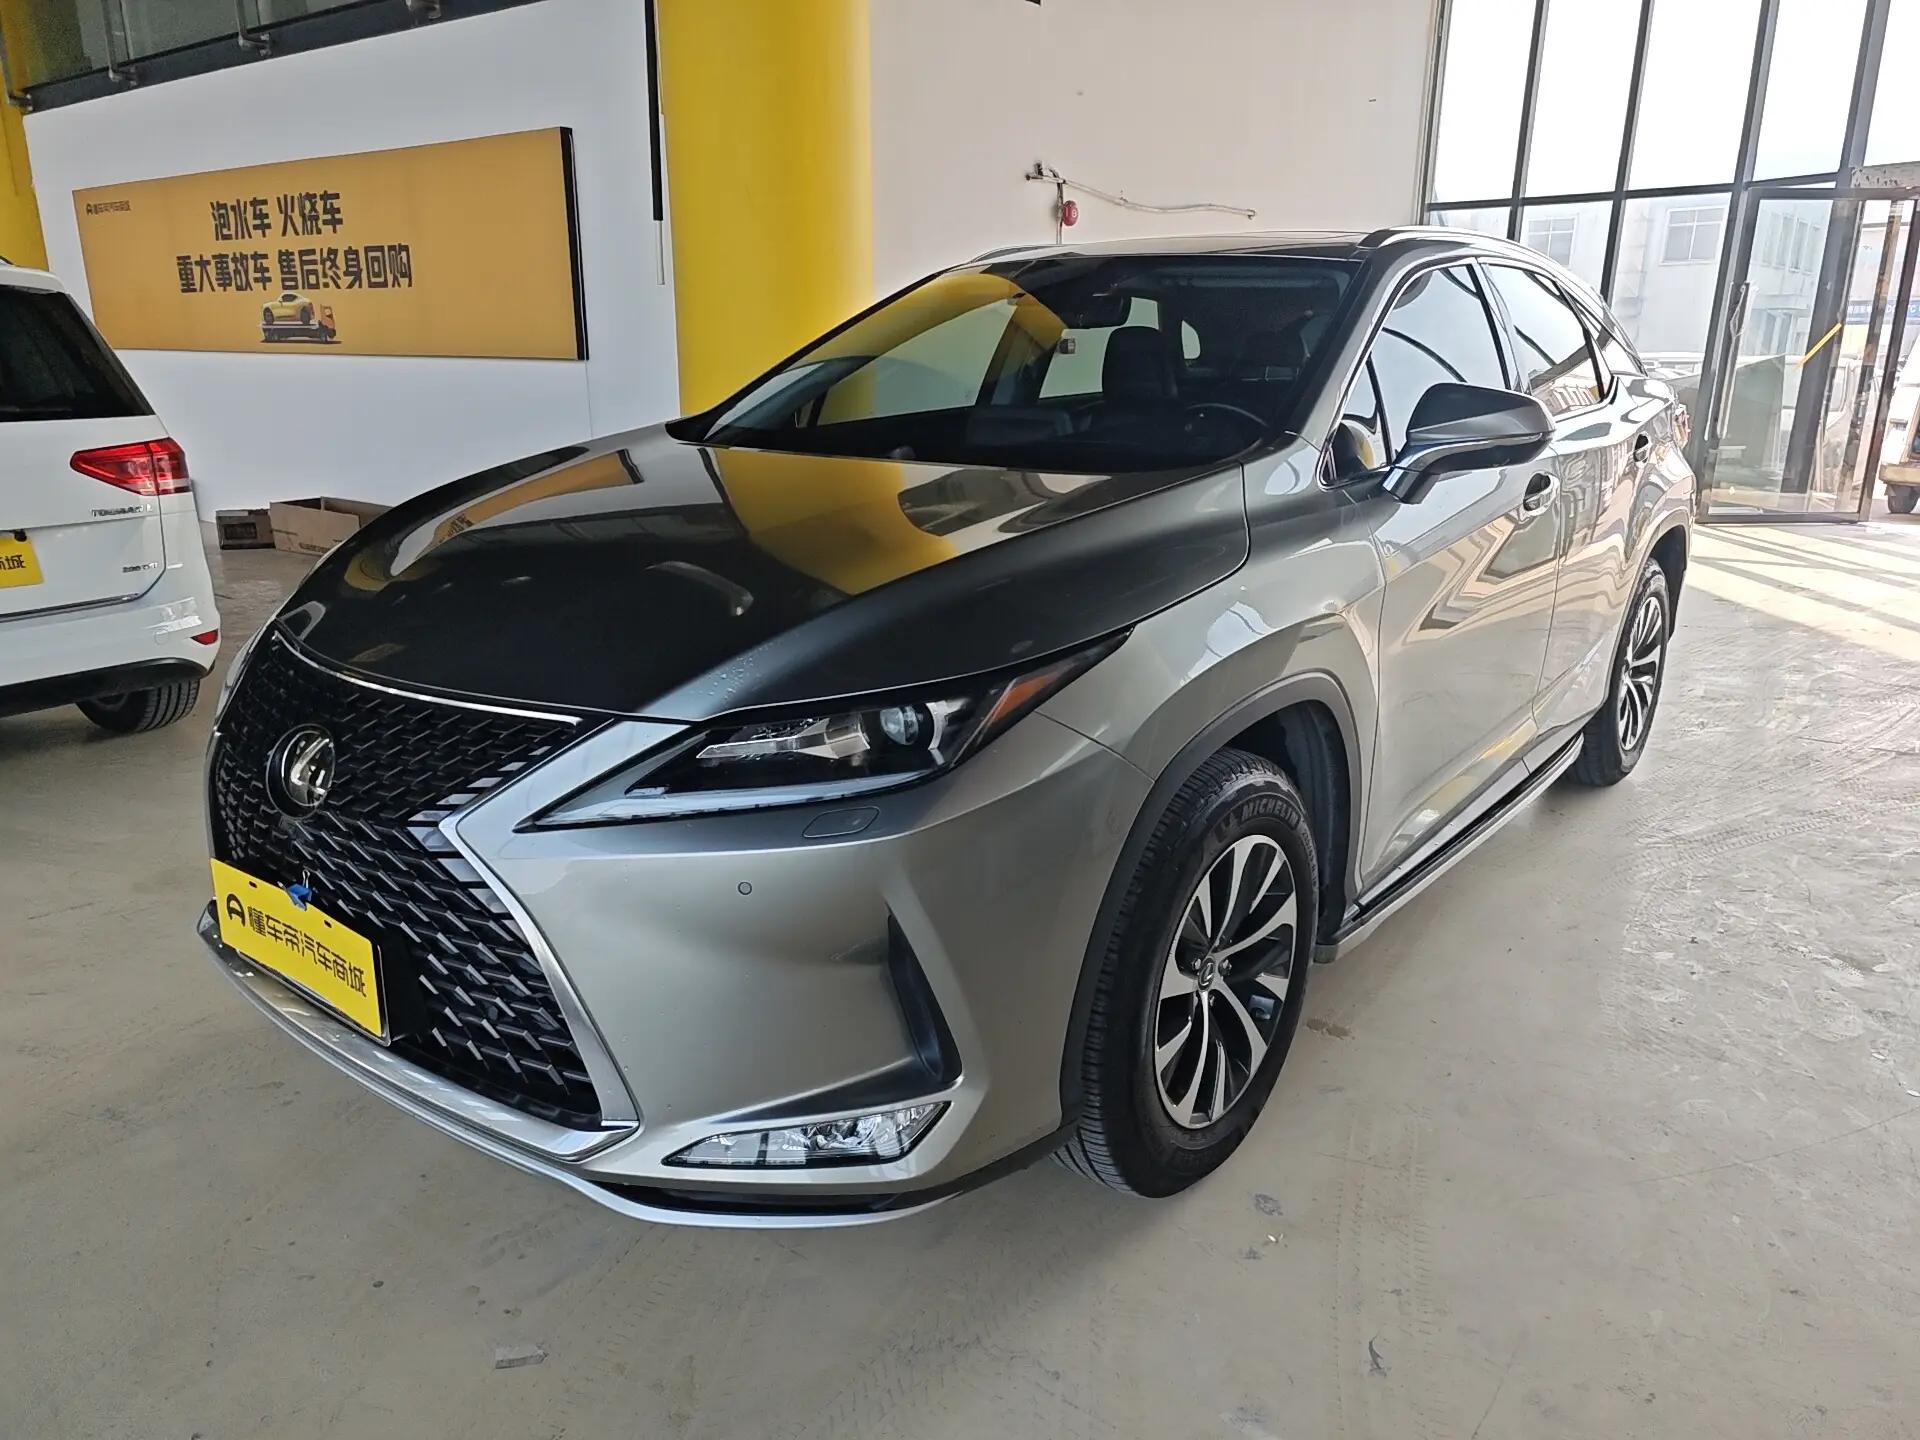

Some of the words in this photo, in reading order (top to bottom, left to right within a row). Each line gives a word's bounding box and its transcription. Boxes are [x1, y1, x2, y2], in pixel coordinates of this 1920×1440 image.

[210, 197, 271, 241] 泡水车
[277, 190, 343, 237] 火烧车
[176, 250, 272, 293] 重大事故车
[277, 243, 412, 291] 售后终身回购
[1241, 799, 1299, 829] MICHELIN
[247, 905, 367, 998] 懂车帝汽车商城
